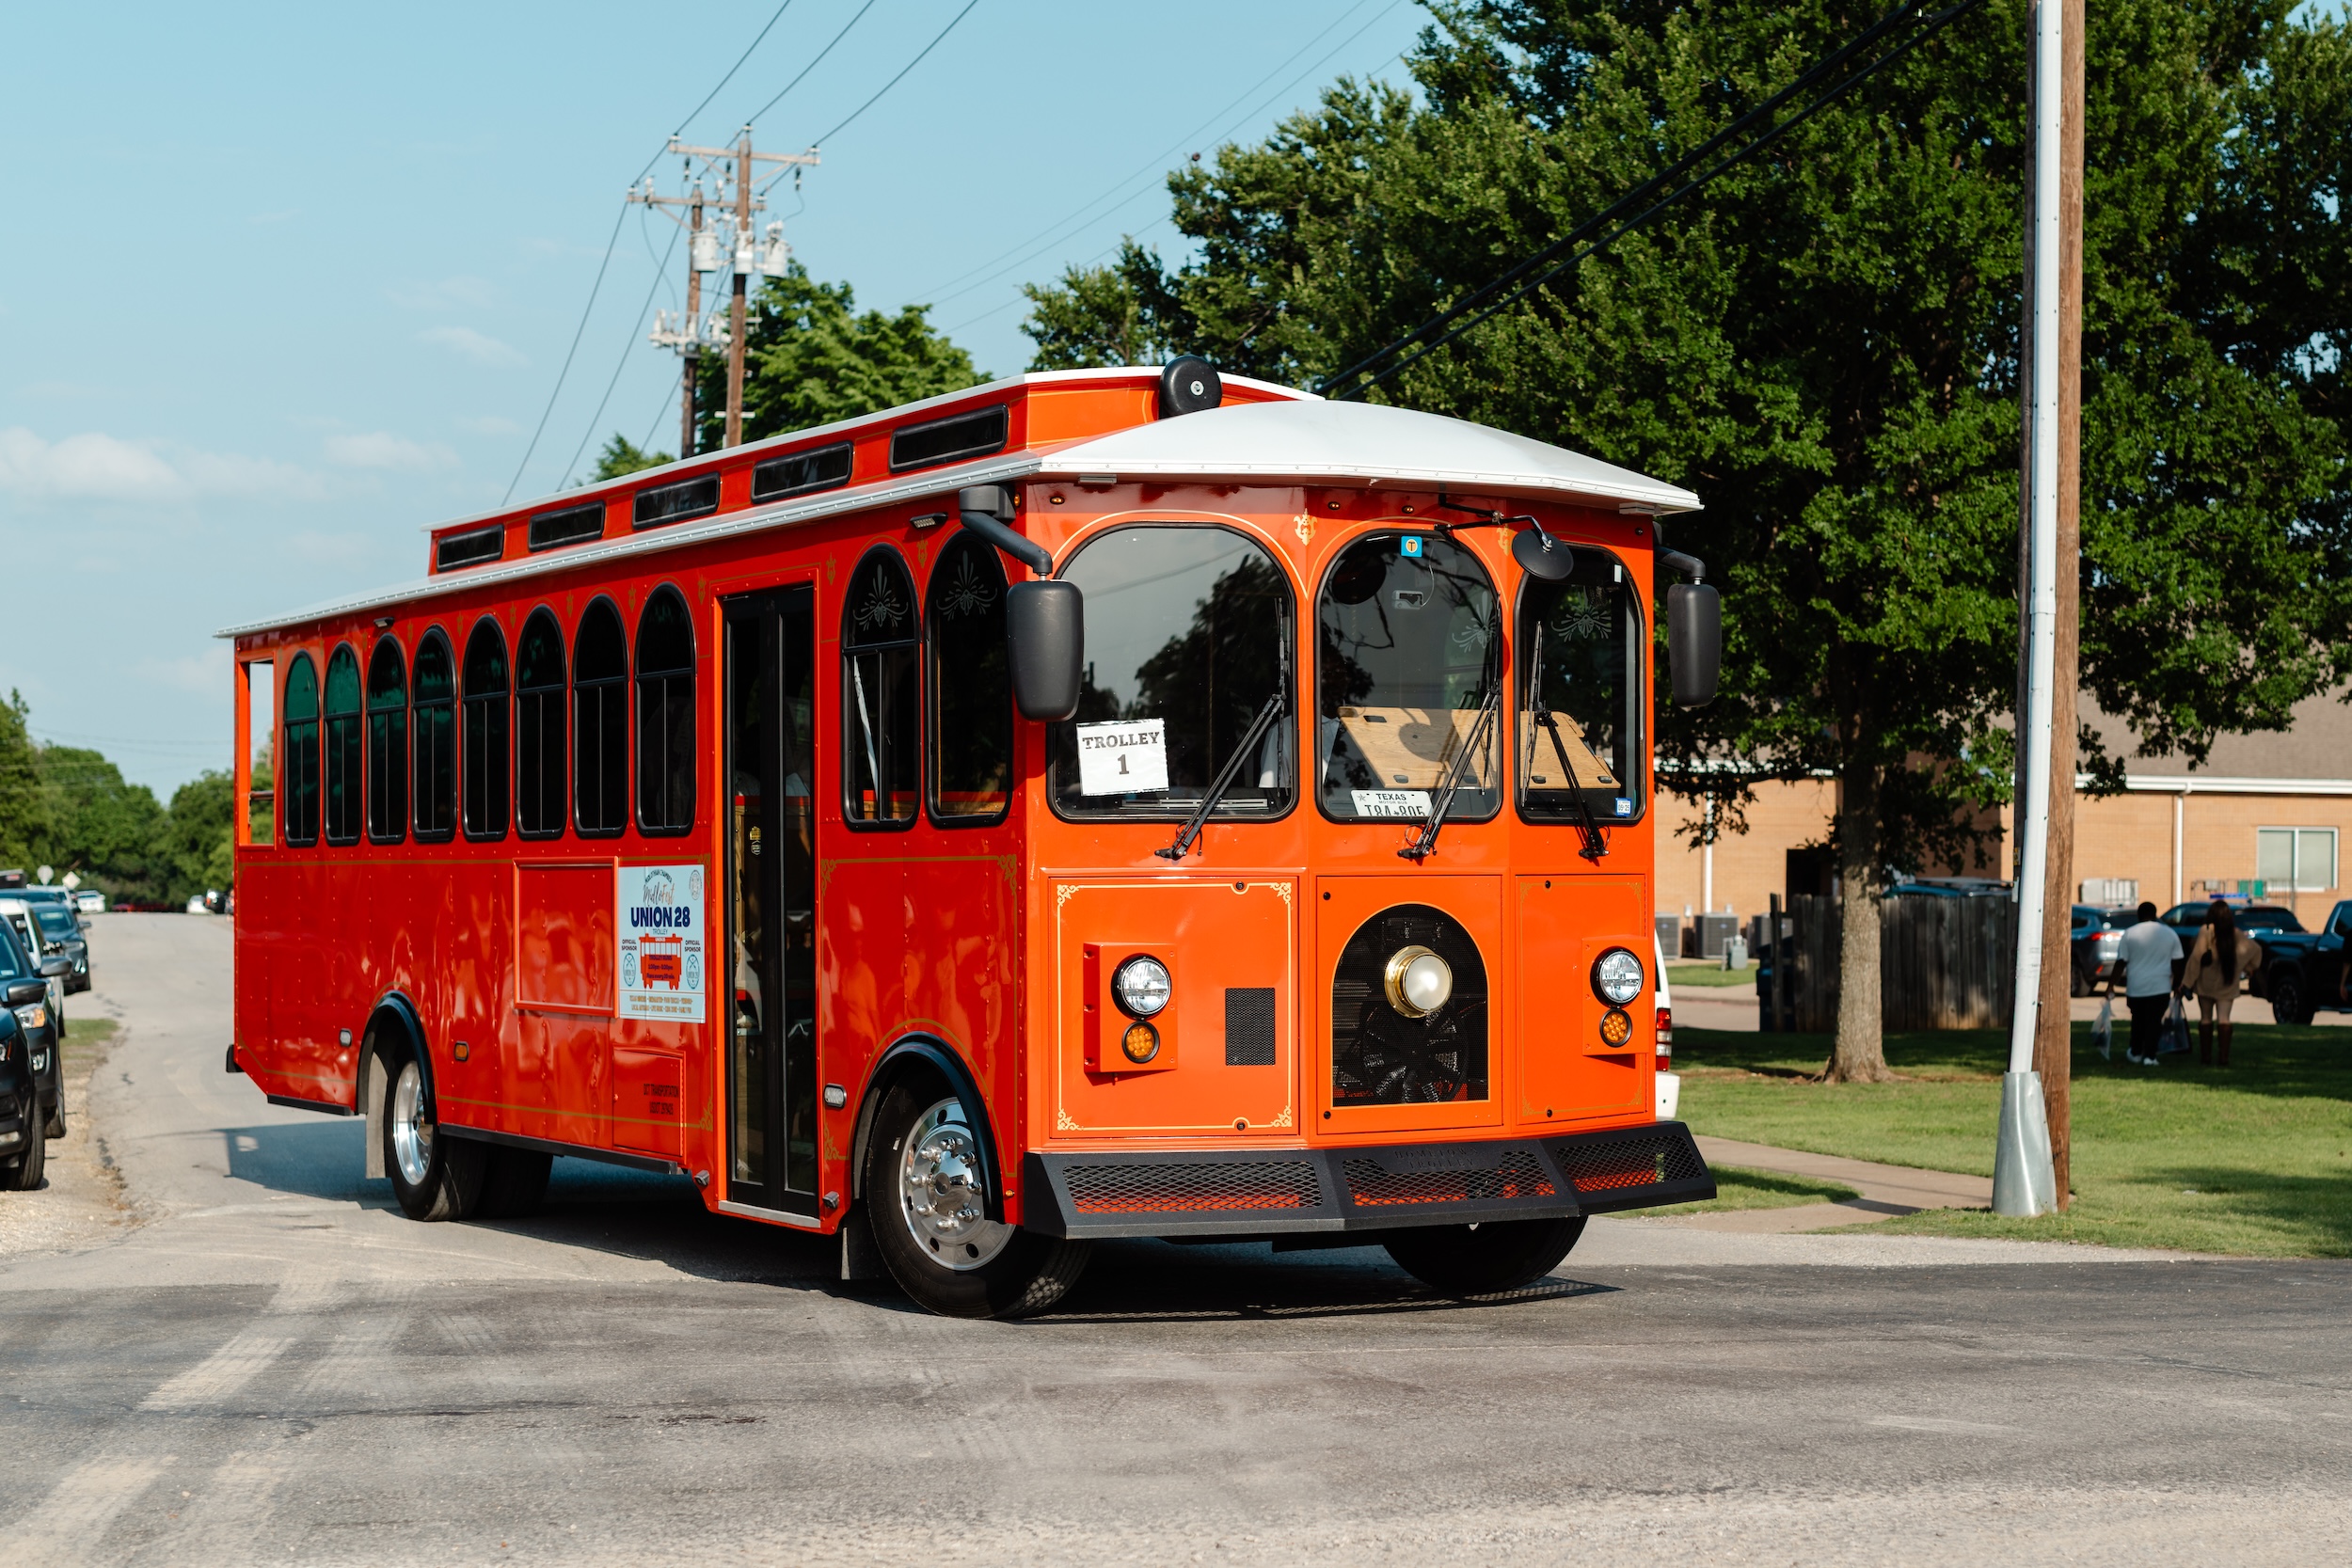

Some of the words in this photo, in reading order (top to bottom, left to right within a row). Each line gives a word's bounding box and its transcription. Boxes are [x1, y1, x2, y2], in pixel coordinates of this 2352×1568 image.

[1082, 731, 1160, 750] TROLLEY
[1117, 753, 1130, 775] 1
[630, 906, 673, 927] UNION
[674, 906, 691, 927] 28
[1394, 1147, 1478, 1159] HOMETOWN
[1407, 1158, 1474, 1169] TROLLEY
